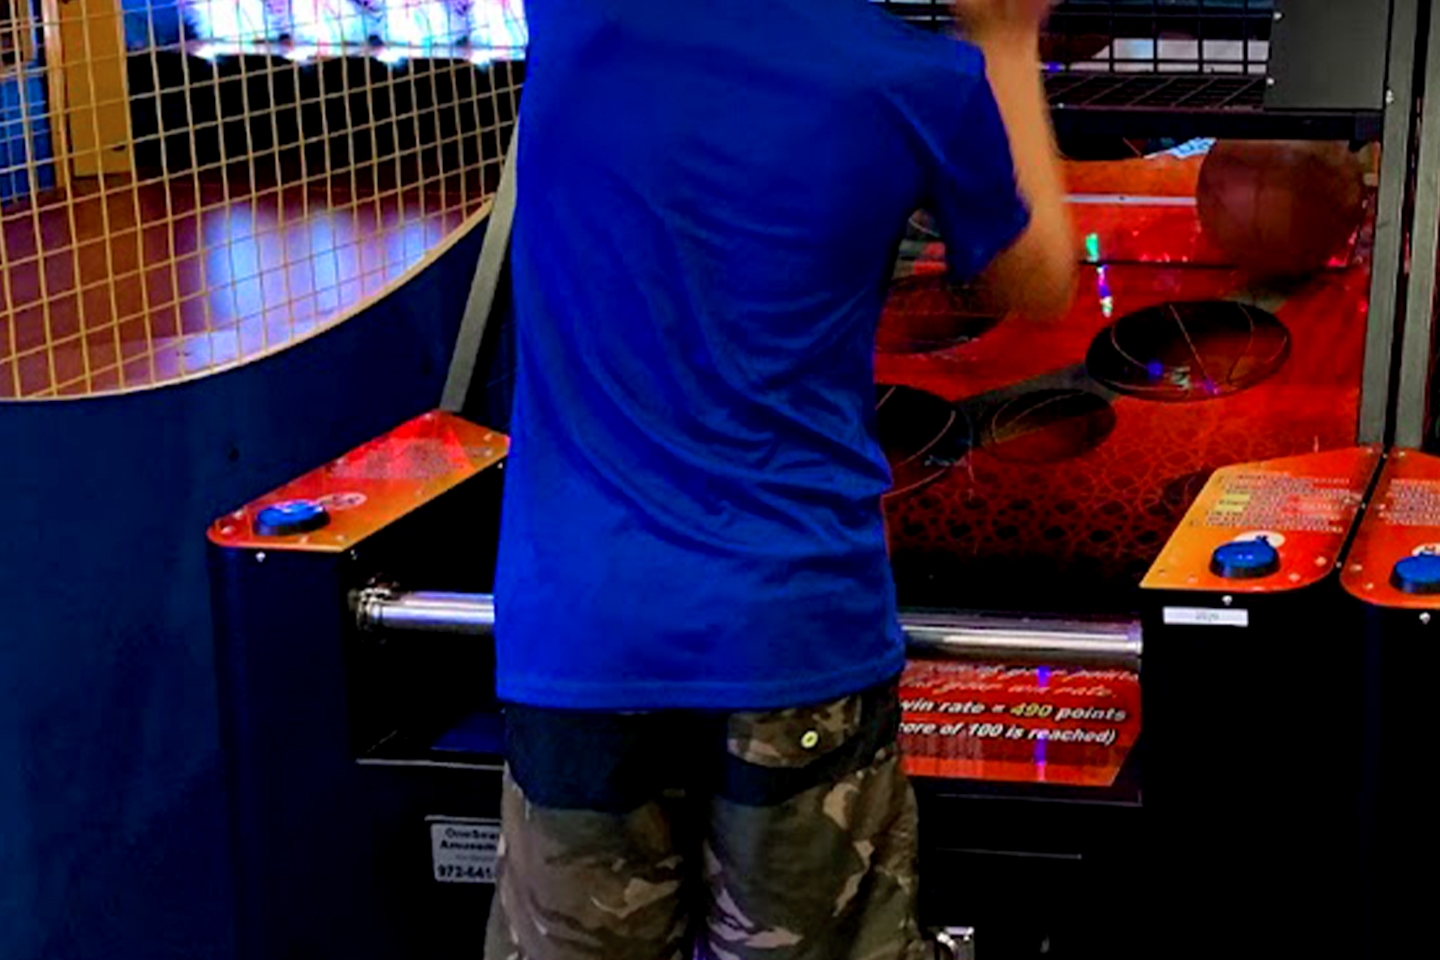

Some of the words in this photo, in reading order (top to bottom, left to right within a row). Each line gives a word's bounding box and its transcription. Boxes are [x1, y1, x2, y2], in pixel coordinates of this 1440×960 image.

[938, 701, 986, 714] rate
[1054, 706, 1127, 722] points
[939, 721, 965, 735] of
[967, 723, 1003, 737] 100
[1004, 723, 1022, 739] is
[1027, 726, 1117, 745] reached)
[440, 839, 498, 851] Amusem
[437, 864, 497, 879] 972-641-
